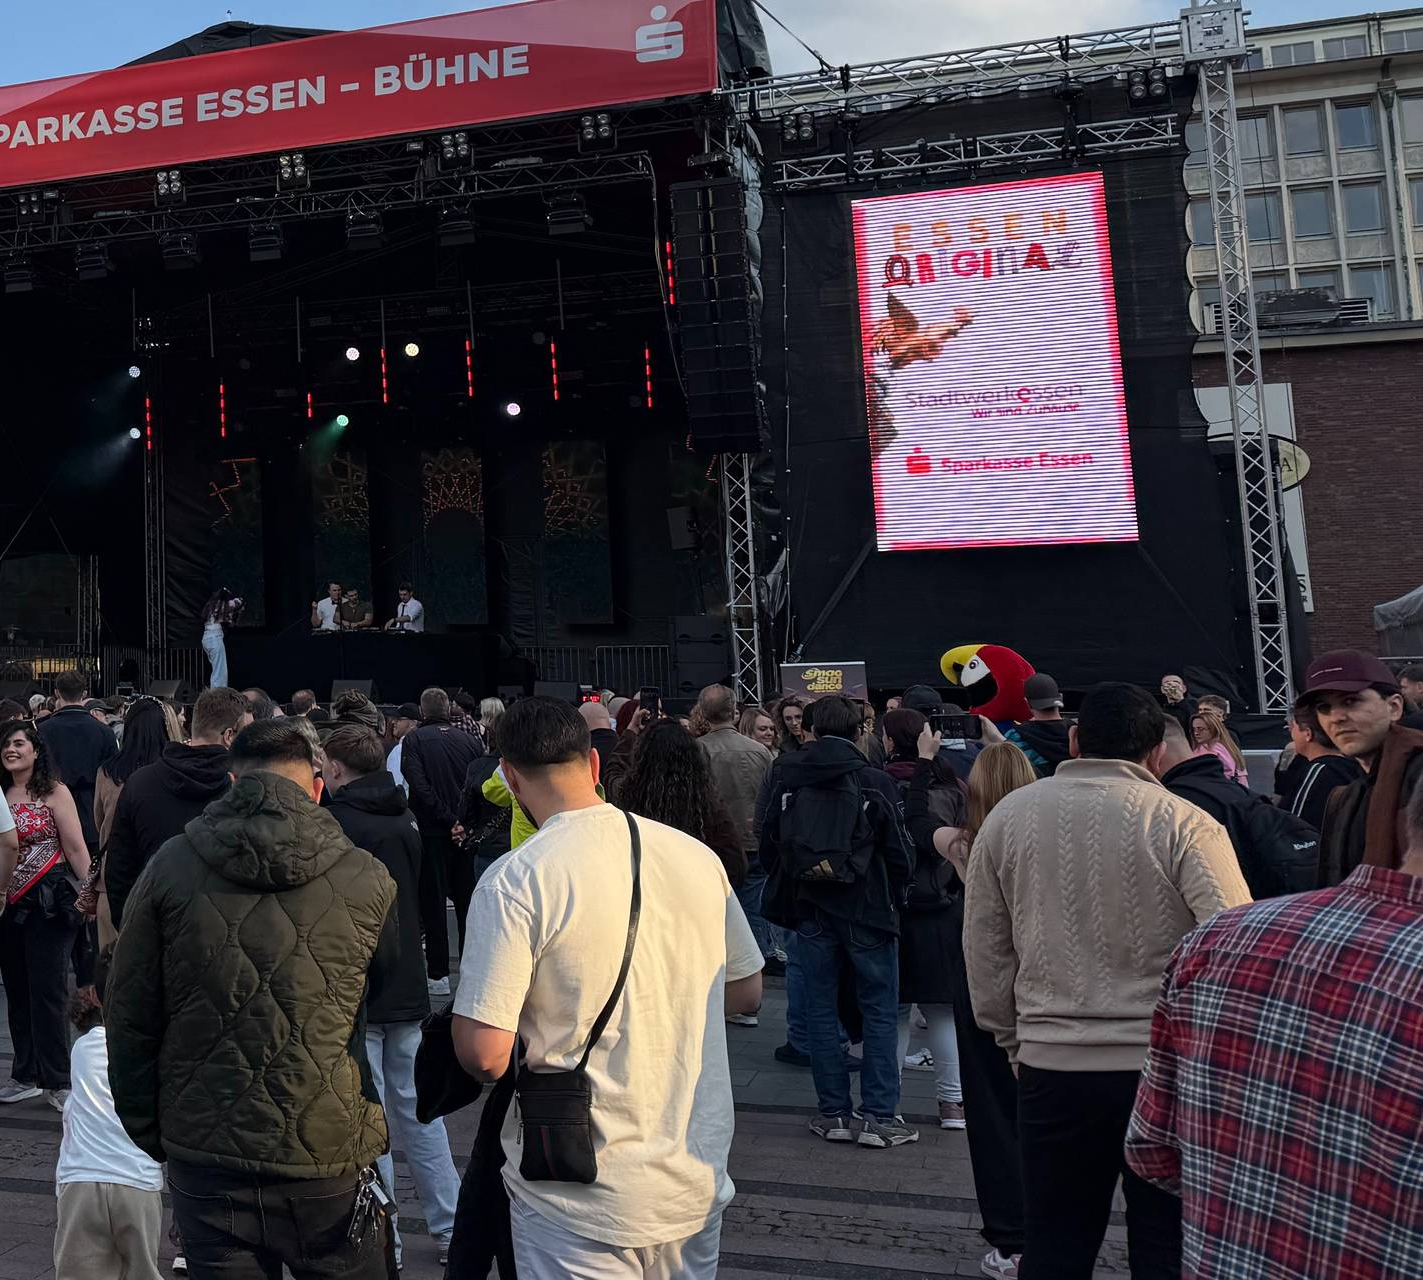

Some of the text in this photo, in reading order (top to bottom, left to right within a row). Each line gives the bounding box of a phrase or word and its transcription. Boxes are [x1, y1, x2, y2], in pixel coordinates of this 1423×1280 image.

[197, 75, 325, 123] ESSEN
[374, 43, 529, 96] BÜHNE
[893, 207, 1067, 252] ESSEN
[1039, 452, 1093, 468] Essen
